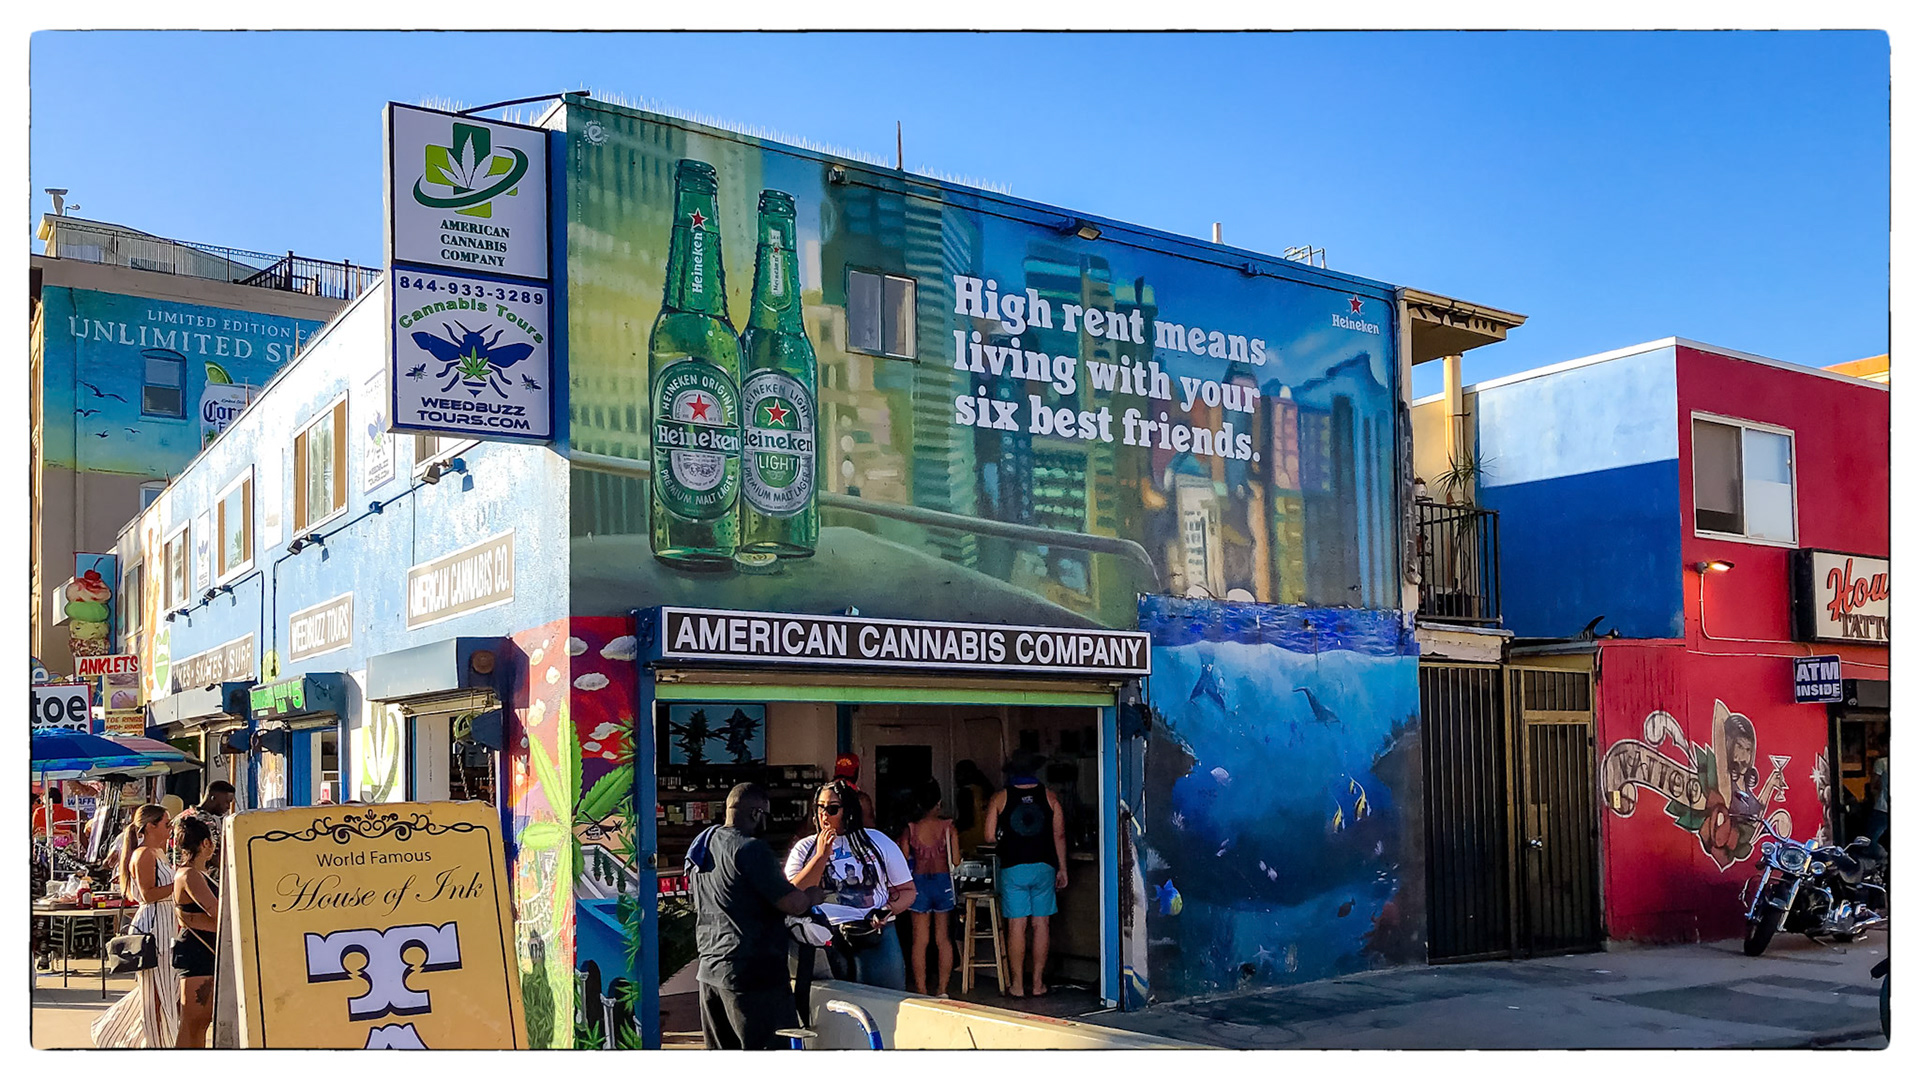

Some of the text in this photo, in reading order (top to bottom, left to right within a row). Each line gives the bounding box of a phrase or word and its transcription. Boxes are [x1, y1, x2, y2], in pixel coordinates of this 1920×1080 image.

[440, 219, 511, 239] AMERICAN
[440, 233, 508, 253] CANNABIS
[441, 249, 505, 267] COMPANY
[691, 232, 703, 294] Heineken
[399, 276, 544, 305] 844-933-3289
[147, 309, 216, 328] LIMITED
[223, 320, 290, 337] EDITION
[399, 297, 544, 345] Cannabis Tours
[953, 275, 1267, 366] High rent means
[1332, 314, 1380, 335] Heineken
[68, 315, 253, 359] UNLIMITED
[953, 331, 1261, 413] living with your
[420, 396, 526, 417] WEEDBUZZ
[662, 374, 736, 418] HEINEKEN ORIGINAL
[744, 383, 786, 412] HEINEKEN
[417, 410, 530, 430] TOURS.COM
[955, 386, 1261, 462] six best friends.
[656, 424, 740, 451] Heineken
[759, 455, 797, 471] LIGHT
[660, 468, 692, 503] PREMIUM
[695, 492, 717, 505] MALT
[717, 474, 735, 500] LAGER
[744, 467, 771, 500] PREMIUM
[794, 472, 811, 497] LAGER
[409, 543, 510, 618] AMERICAN CANNABIS CO.
[291, 602, 349, 654] WEEDBUZZ TOURS
[673, 616, 1144, 667] AMERICAN CANNABIS COMPANY
[78, 655, 139, 675] ANKLETS
[195, 653, 223, 684] SKATES
[229, 642, 251, 674] SURF
[1796, 662, 1839, 682] ATM
[1796, 683, 1840, 696] INSIDE
[32, 690, 88, 724] toe
[316, 850, 432, 867] World Famous
[271, 873, 376, 913] House
[382, 874, 416, 917] of
[415, 865, 485, 902] Ink
